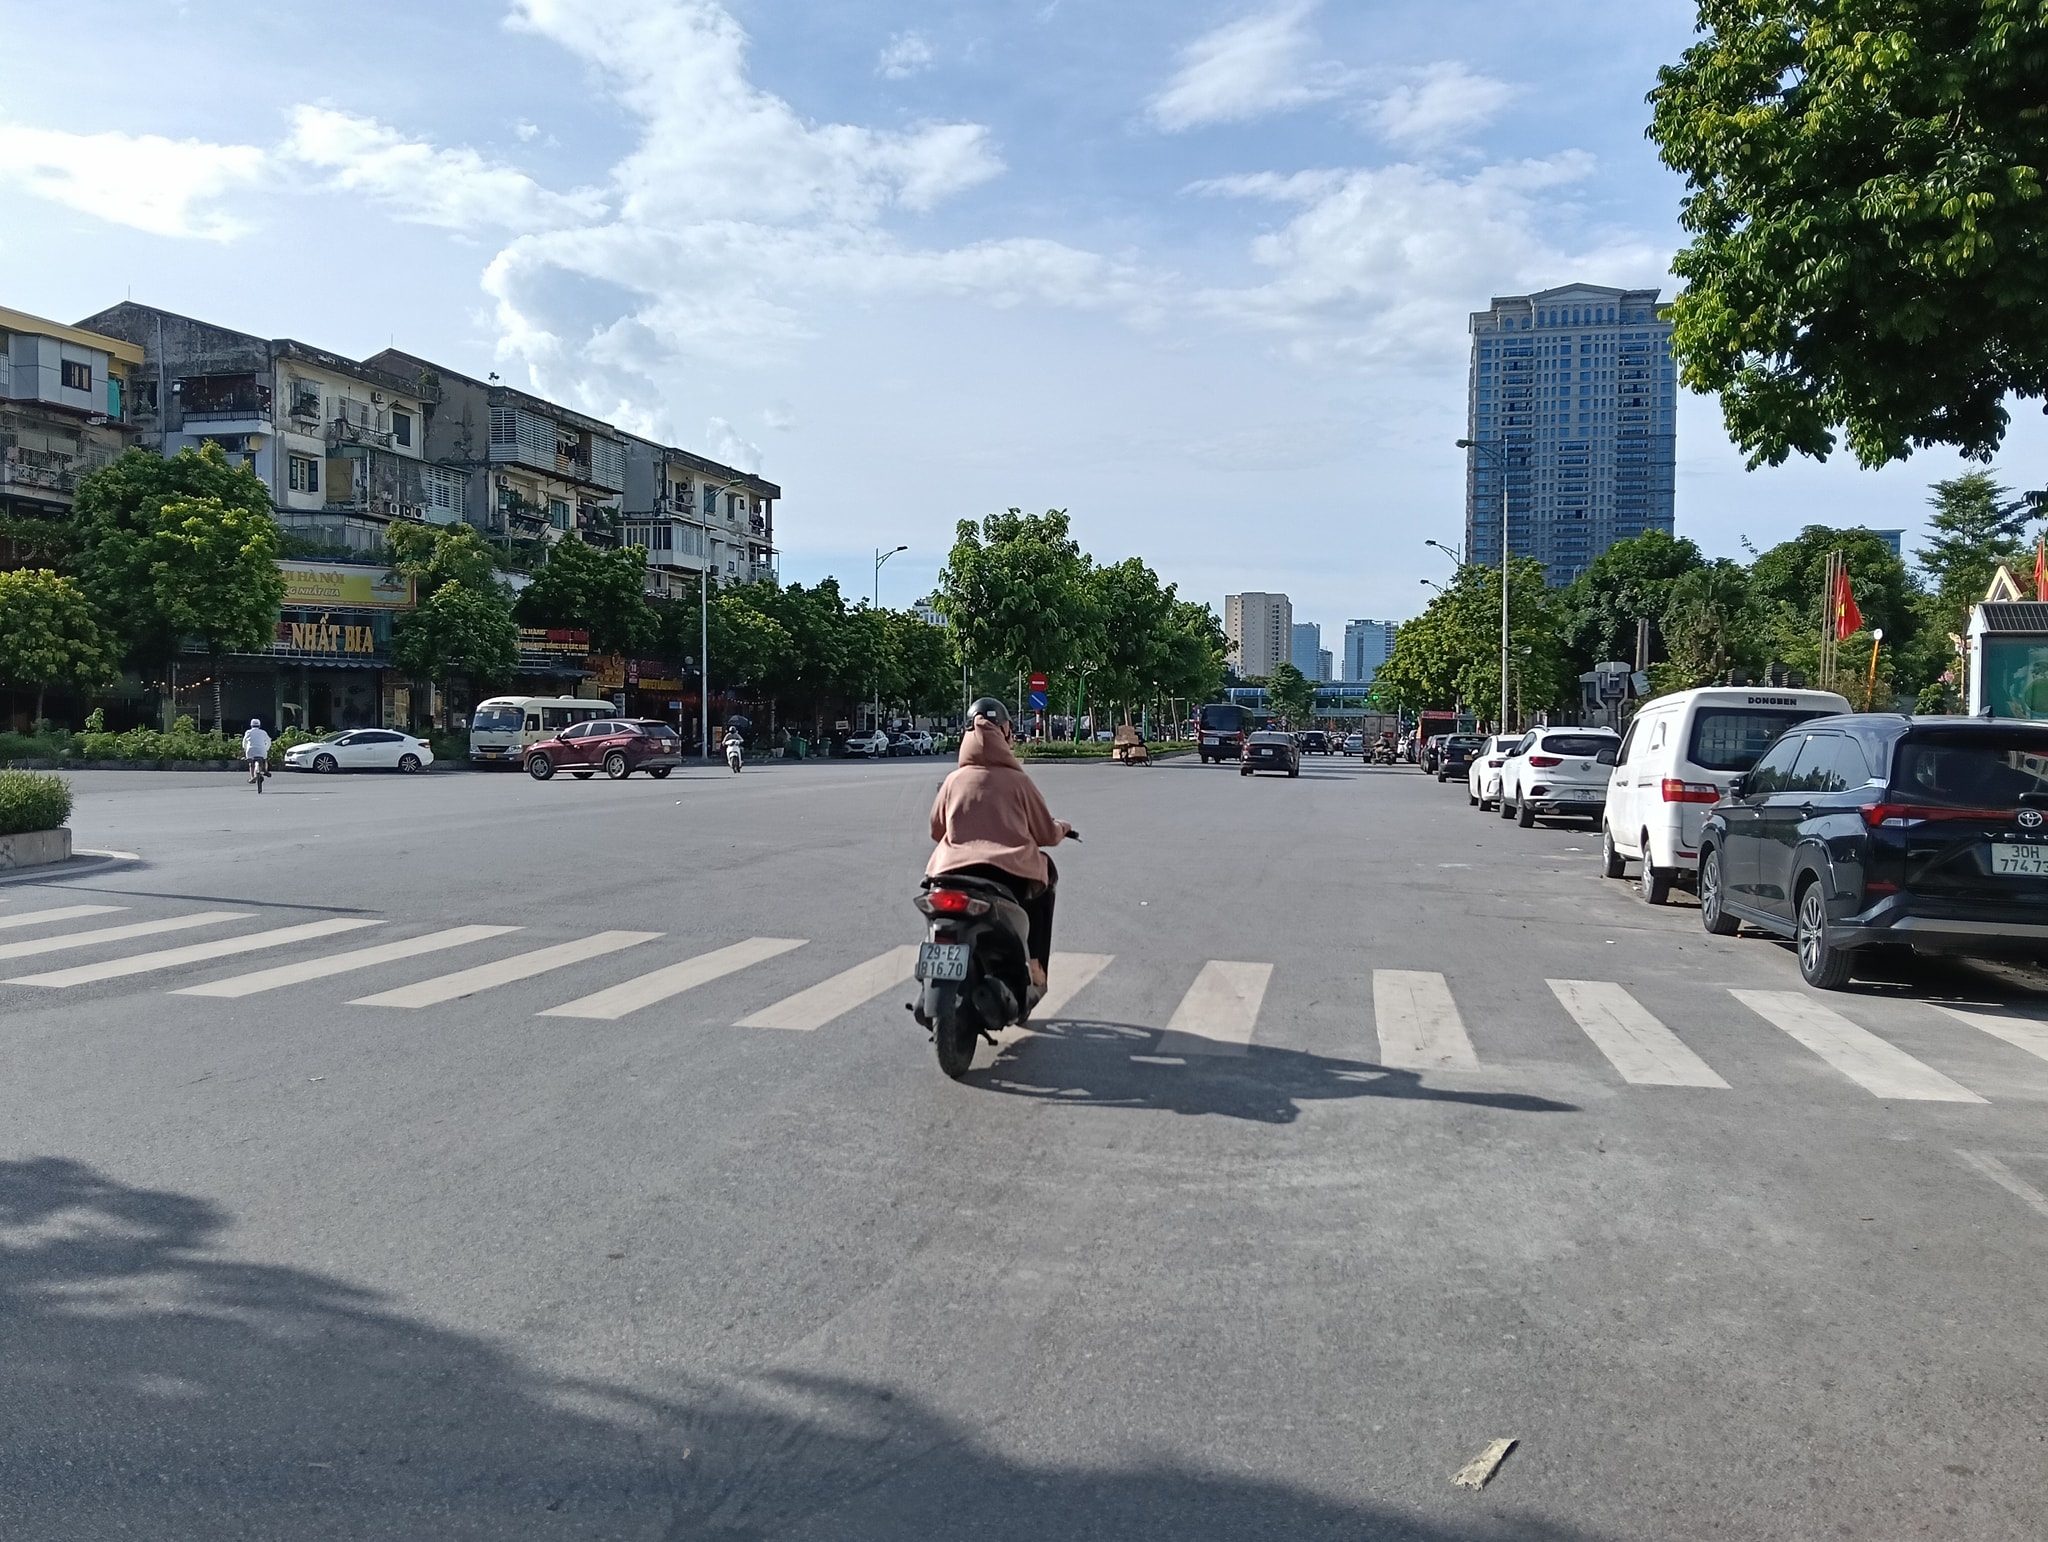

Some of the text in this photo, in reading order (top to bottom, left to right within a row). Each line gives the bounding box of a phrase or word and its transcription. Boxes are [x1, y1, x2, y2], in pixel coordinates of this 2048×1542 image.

[297, 569, 318, 583] HÀ
[319, 571, 346, 587] NỘI
[324, 588, 341, 597] BIA
[344, 625, 375, 653] BIA
[1748, 697, 1797, 706] DONGBEN
[2011, 845, 2040, 859] 30H
[926, 945, 961, 961] 29-E2
[921, 961, 963, 977] 816.70
